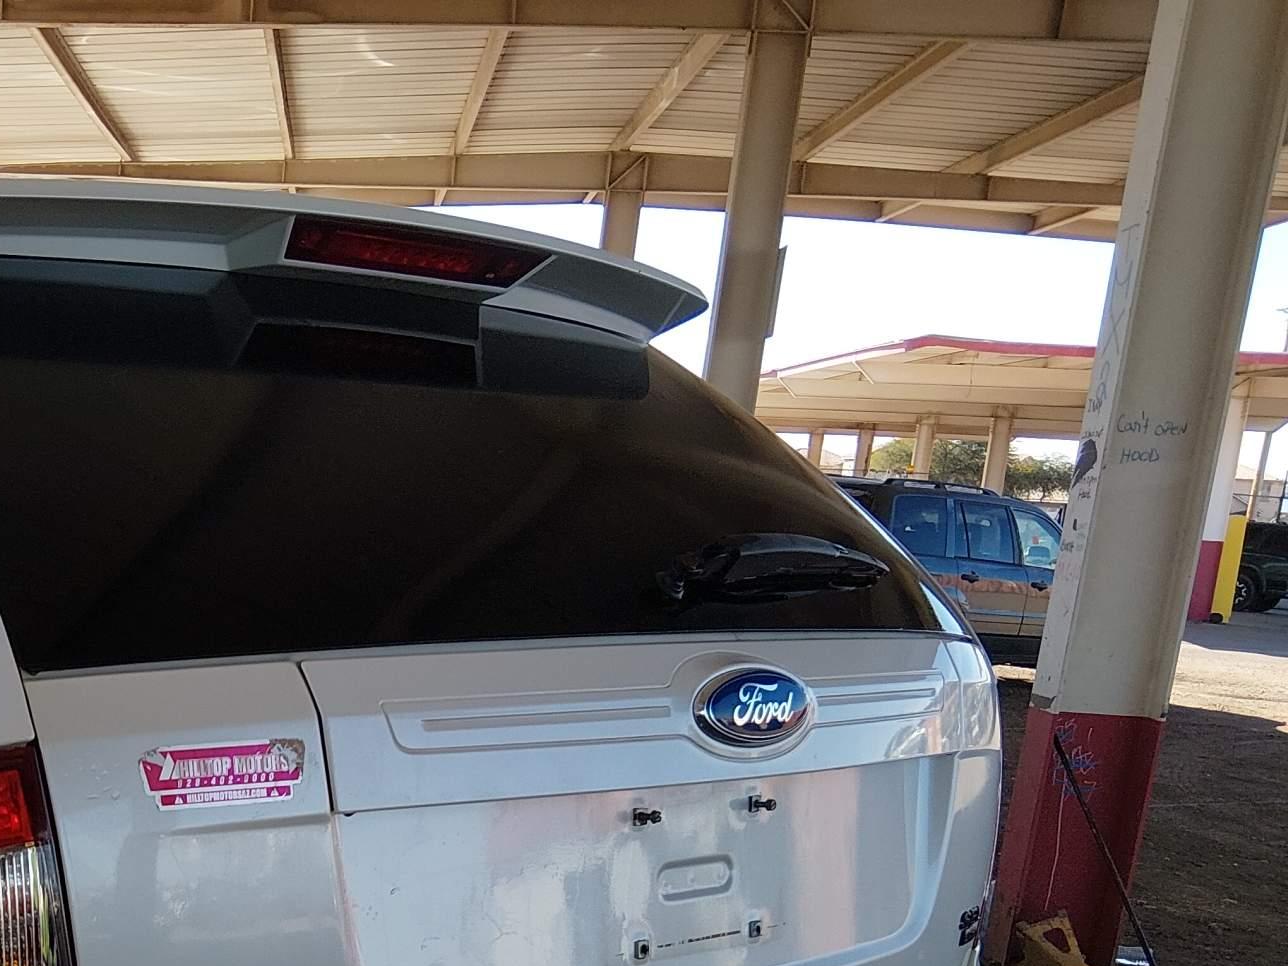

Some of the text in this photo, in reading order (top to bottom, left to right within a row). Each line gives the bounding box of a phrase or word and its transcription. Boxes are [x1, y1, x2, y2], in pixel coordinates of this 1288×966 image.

[1117, 410, 1150, 434] Can't
[733, 683, 794, 726] Ford
[179, 753, 289, 778] HILLTOP MOTORS
